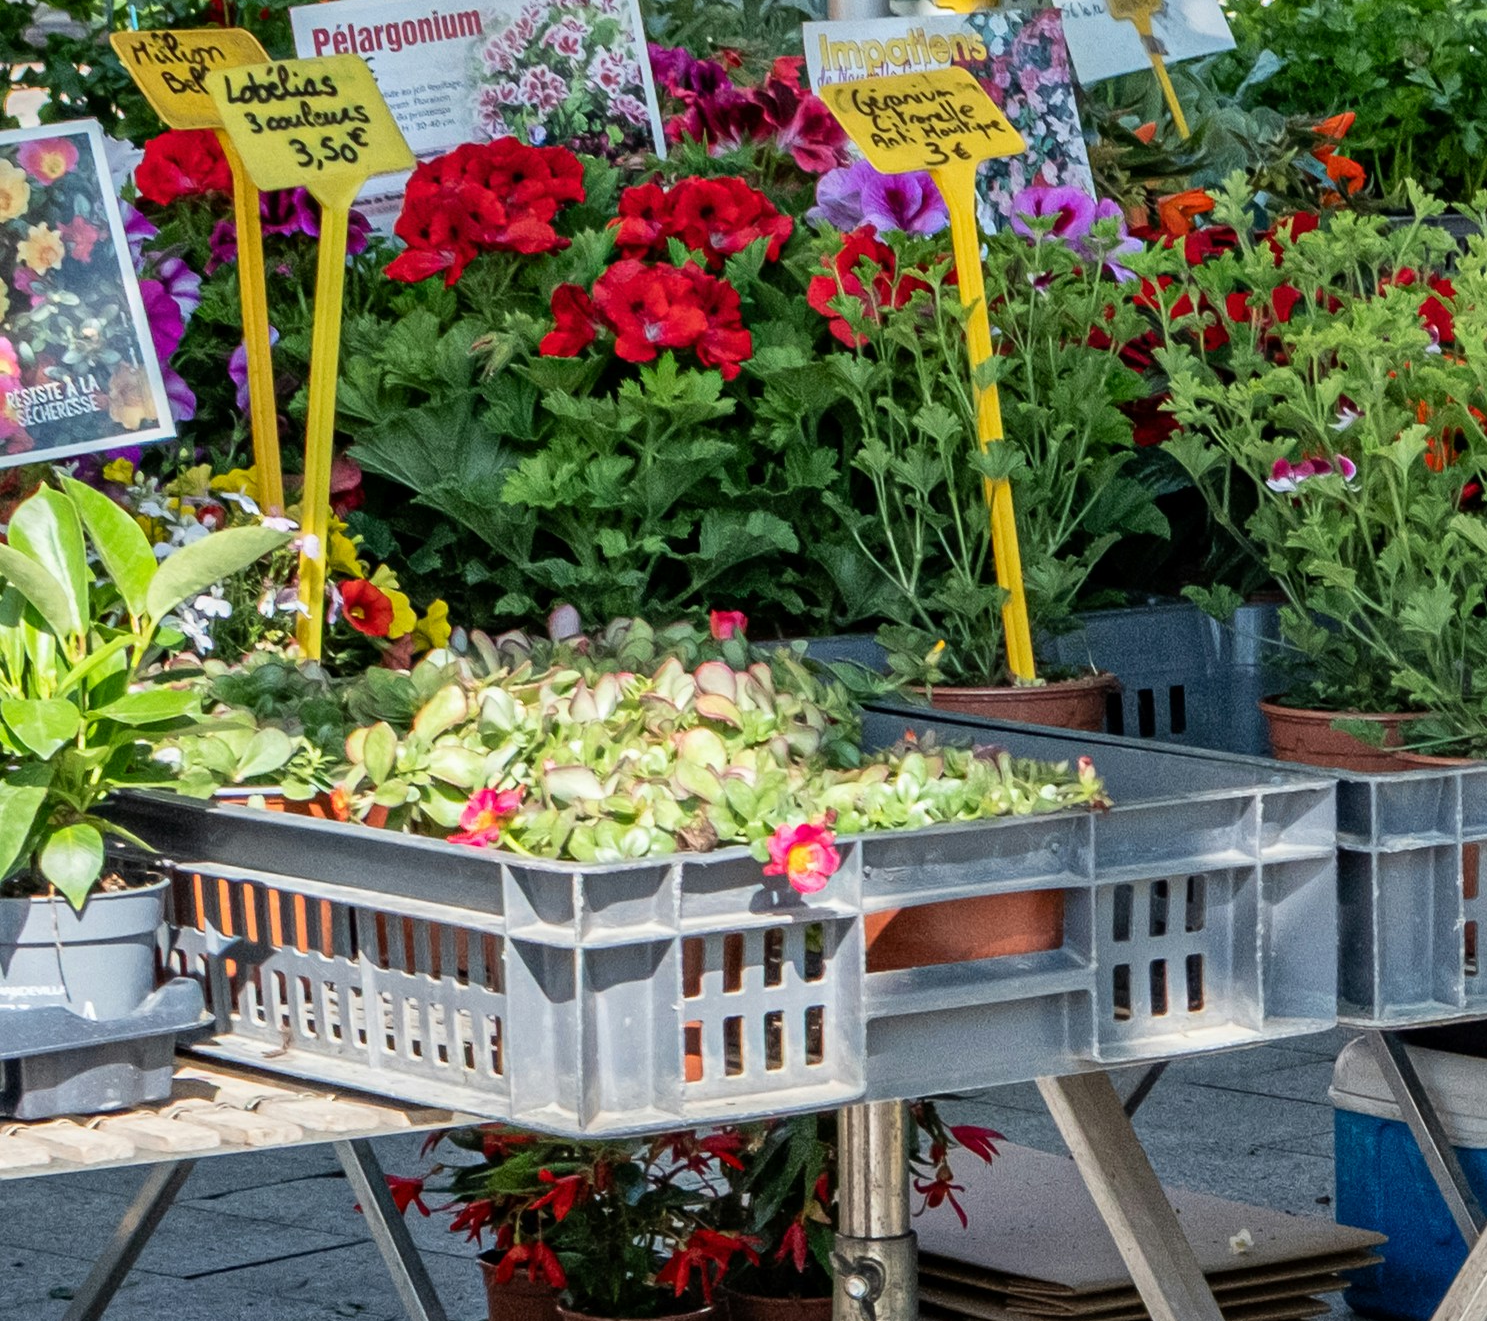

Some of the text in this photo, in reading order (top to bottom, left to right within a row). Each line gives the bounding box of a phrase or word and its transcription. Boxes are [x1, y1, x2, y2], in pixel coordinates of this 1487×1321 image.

[312, 9, 483, 58] Pélargonium
[818, 27, 989, 73] Impatiens
[224, 64, 338, 104] Lobélias
[244, 101, 371, 134] 3 couleurs
[924, 142, 950, 166] 3
[78, 373, 101, 394] LA
